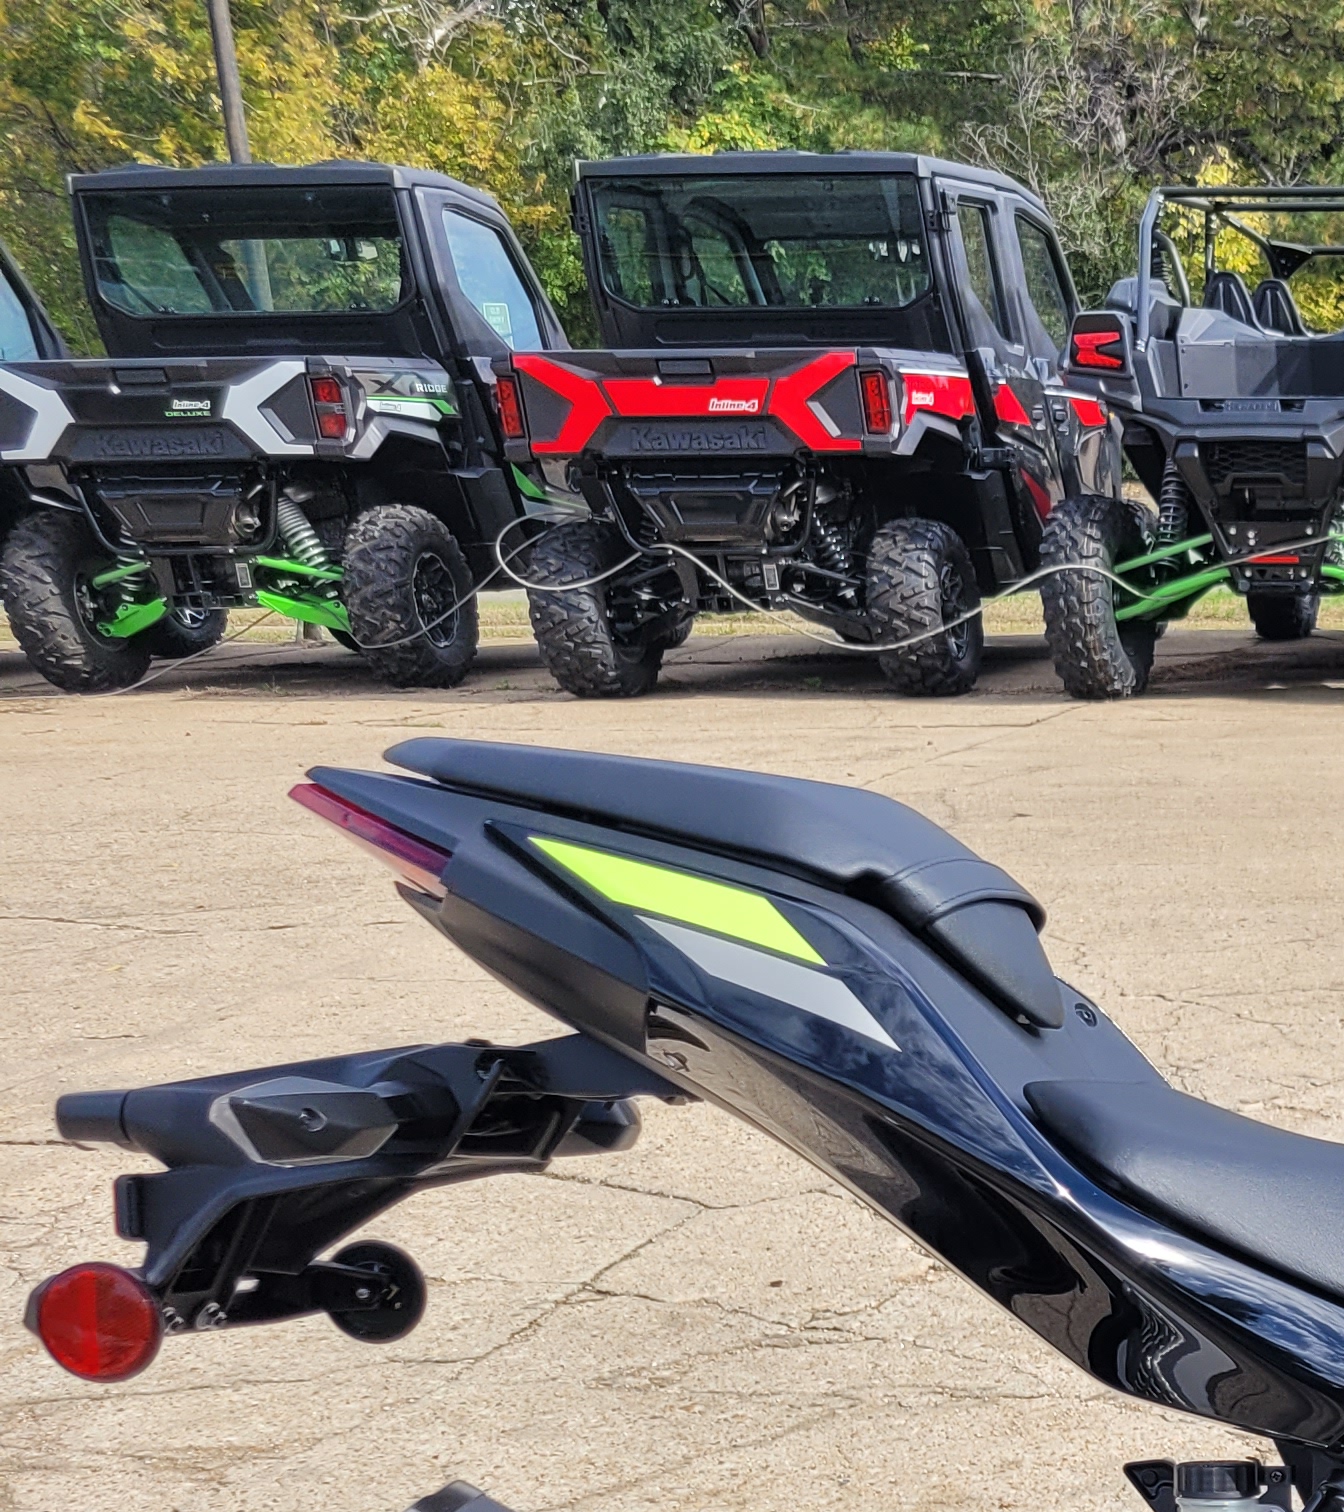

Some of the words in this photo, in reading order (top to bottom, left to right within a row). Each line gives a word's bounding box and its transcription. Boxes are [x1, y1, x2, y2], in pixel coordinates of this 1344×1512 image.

[708, 398, 746, 411] Inline
[745, 399, 759, 412] 4
[99, 431, 224, 456] Kawasaki
[631, 426, 767, 450] Kawasaki
